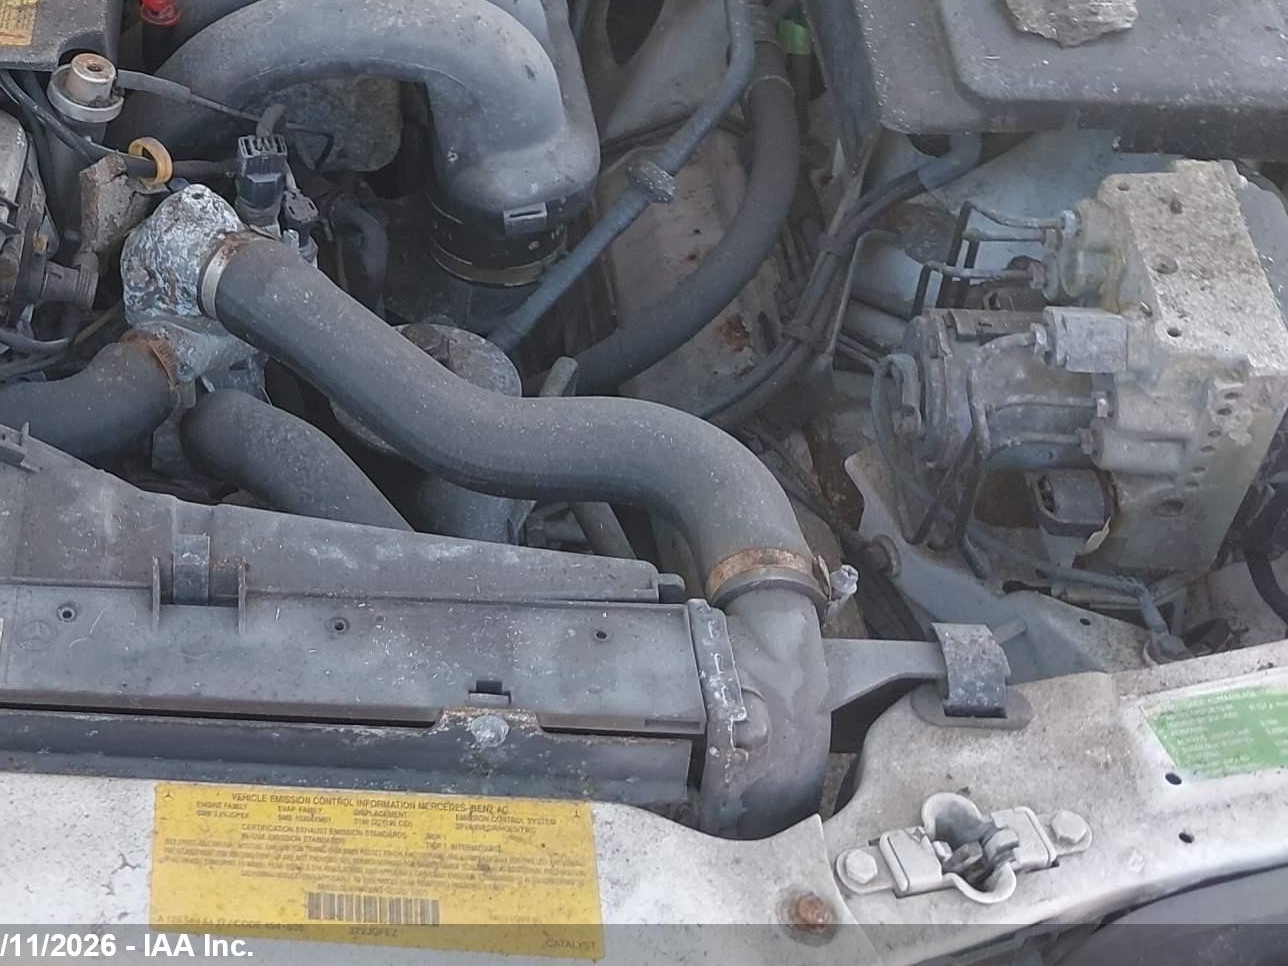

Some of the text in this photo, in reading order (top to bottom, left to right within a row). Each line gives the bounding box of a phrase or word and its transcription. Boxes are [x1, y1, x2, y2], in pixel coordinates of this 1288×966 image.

[232, 793, 266, 802] VEHICLE
[270, 795, 310, 804] EMISSION
[313, 797, 353, 806] CONTROL
[356, 799, 415, 809] INFORMATION
[418, 801, 493, 813] MERCEDES-BENZ
[545, 938, 597, 952] CATALYST
